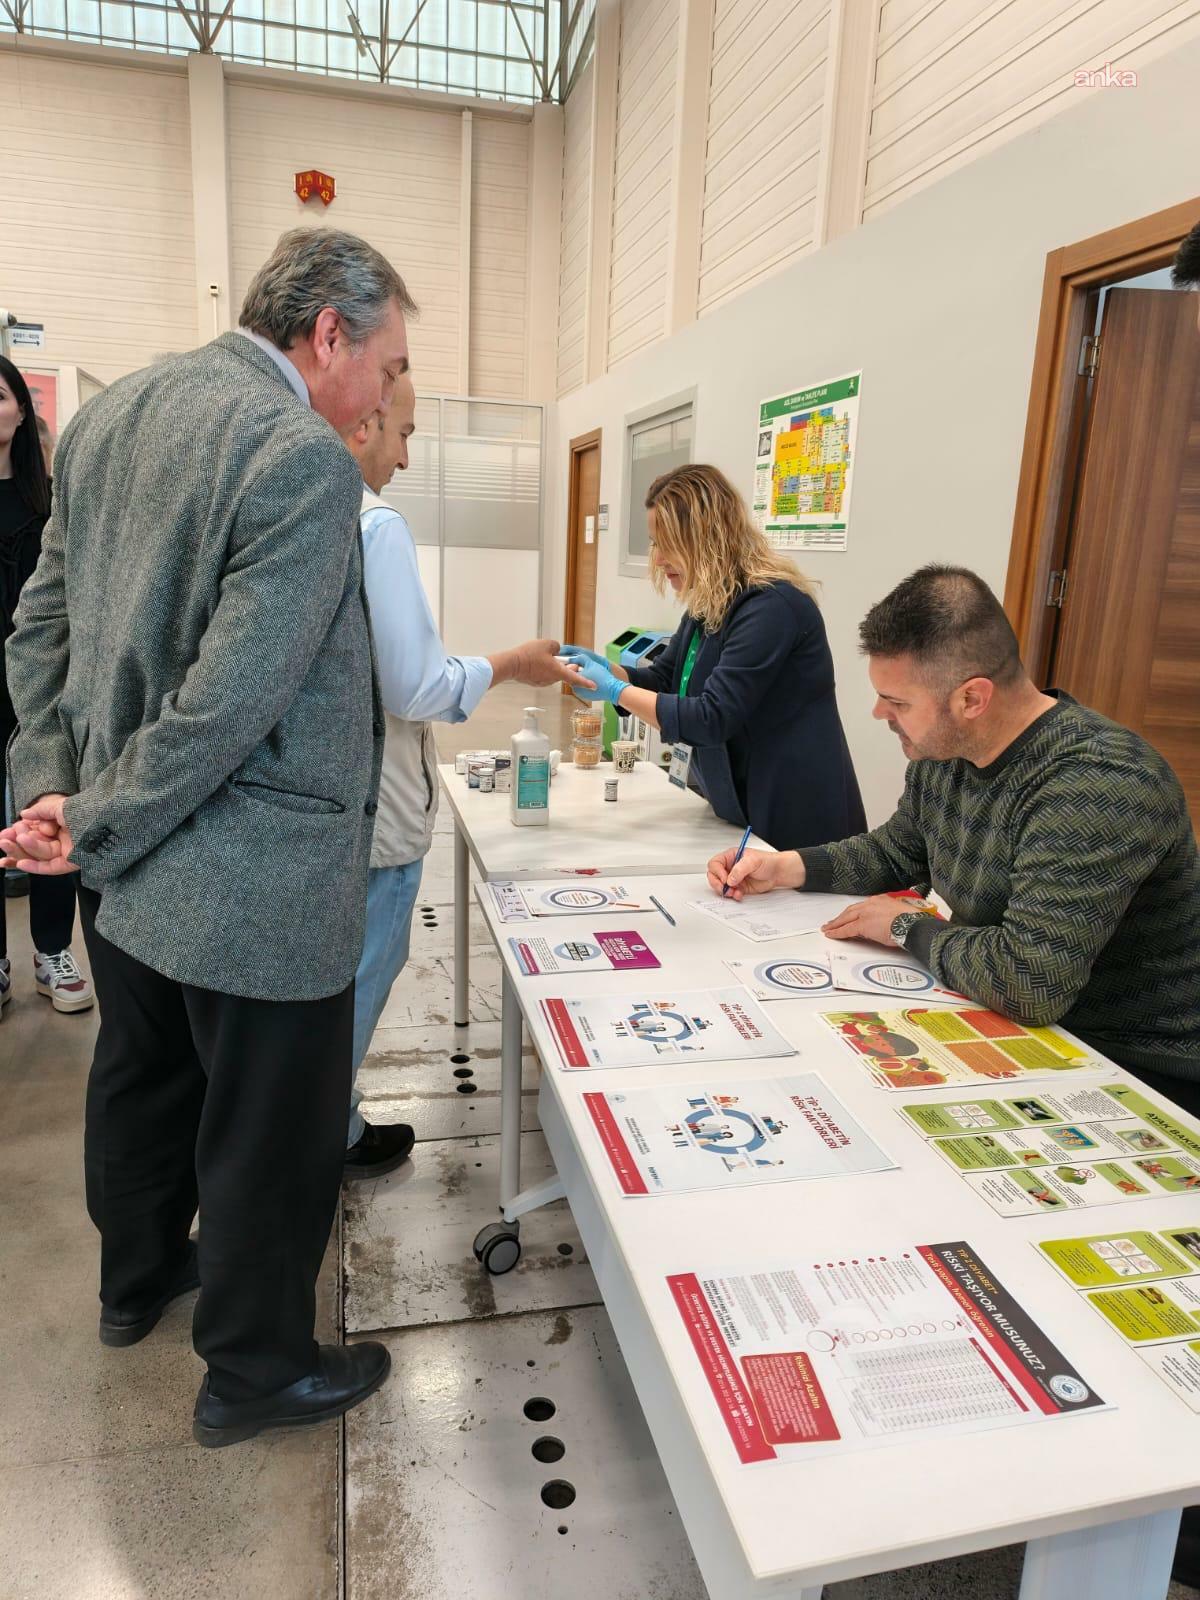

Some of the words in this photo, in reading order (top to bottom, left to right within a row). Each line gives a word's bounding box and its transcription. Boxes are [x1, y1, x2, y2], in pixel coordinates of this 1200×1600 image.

[790, 1095, 807, 1110] RİSK
[802, 1110, 841, 1149] FAKTÖRLERİ
[804, 1096, 819, 1108] TİP
[817, 1111, 851, 1146] DİYABETİN
[957, 1248, 968, 1258] TİP
[925, 1253, 940, 1267] Testi
[952, 1287, 973, 1309] hemen
[970, 1311, 995, 1338] öğrenin
[941, 1250, 968, 1272] RİSKİ
[960, 1273, 996, 1311] TAŞIYOR
[992, 1313, 1046, 1371] MUSUNUZ?
[794, 1355, 810, 1382] Riskinizi
[805, 1383, 821, 1409] Azaltın
[739, 1404, 754, 1426] ARAYIN
